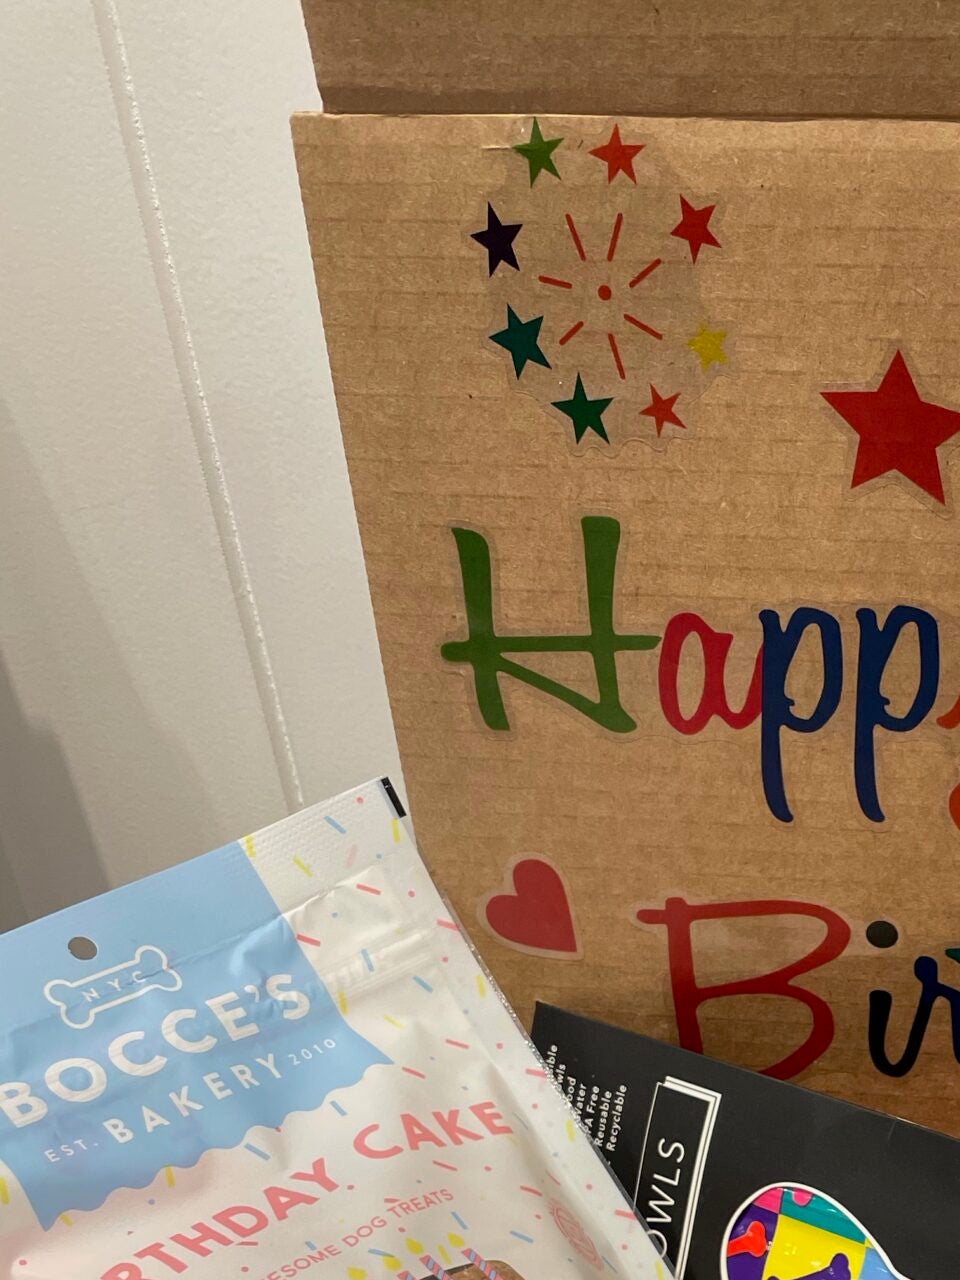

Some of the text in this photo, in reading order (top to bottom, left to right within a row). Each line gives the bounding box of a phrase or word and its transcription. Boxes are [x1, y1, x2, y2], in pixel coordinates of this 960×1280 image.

[0, 973, 311, 1129] BOCCE'S
[44, 1036, 337, 1164] EST. BAKERY 2010
[352, 1100, 516, 1161] CAKE
[586, 1085, 600, 1114] Free
[594, 1090, 613, 1147] Reusable
[605, 1084, 628, 1152] Recyclable
[341, 1214, 388, 1247] DOG
[387, 1187, 455, 1219] TREATS
[646, 1137, 685, 1260] OWLS
